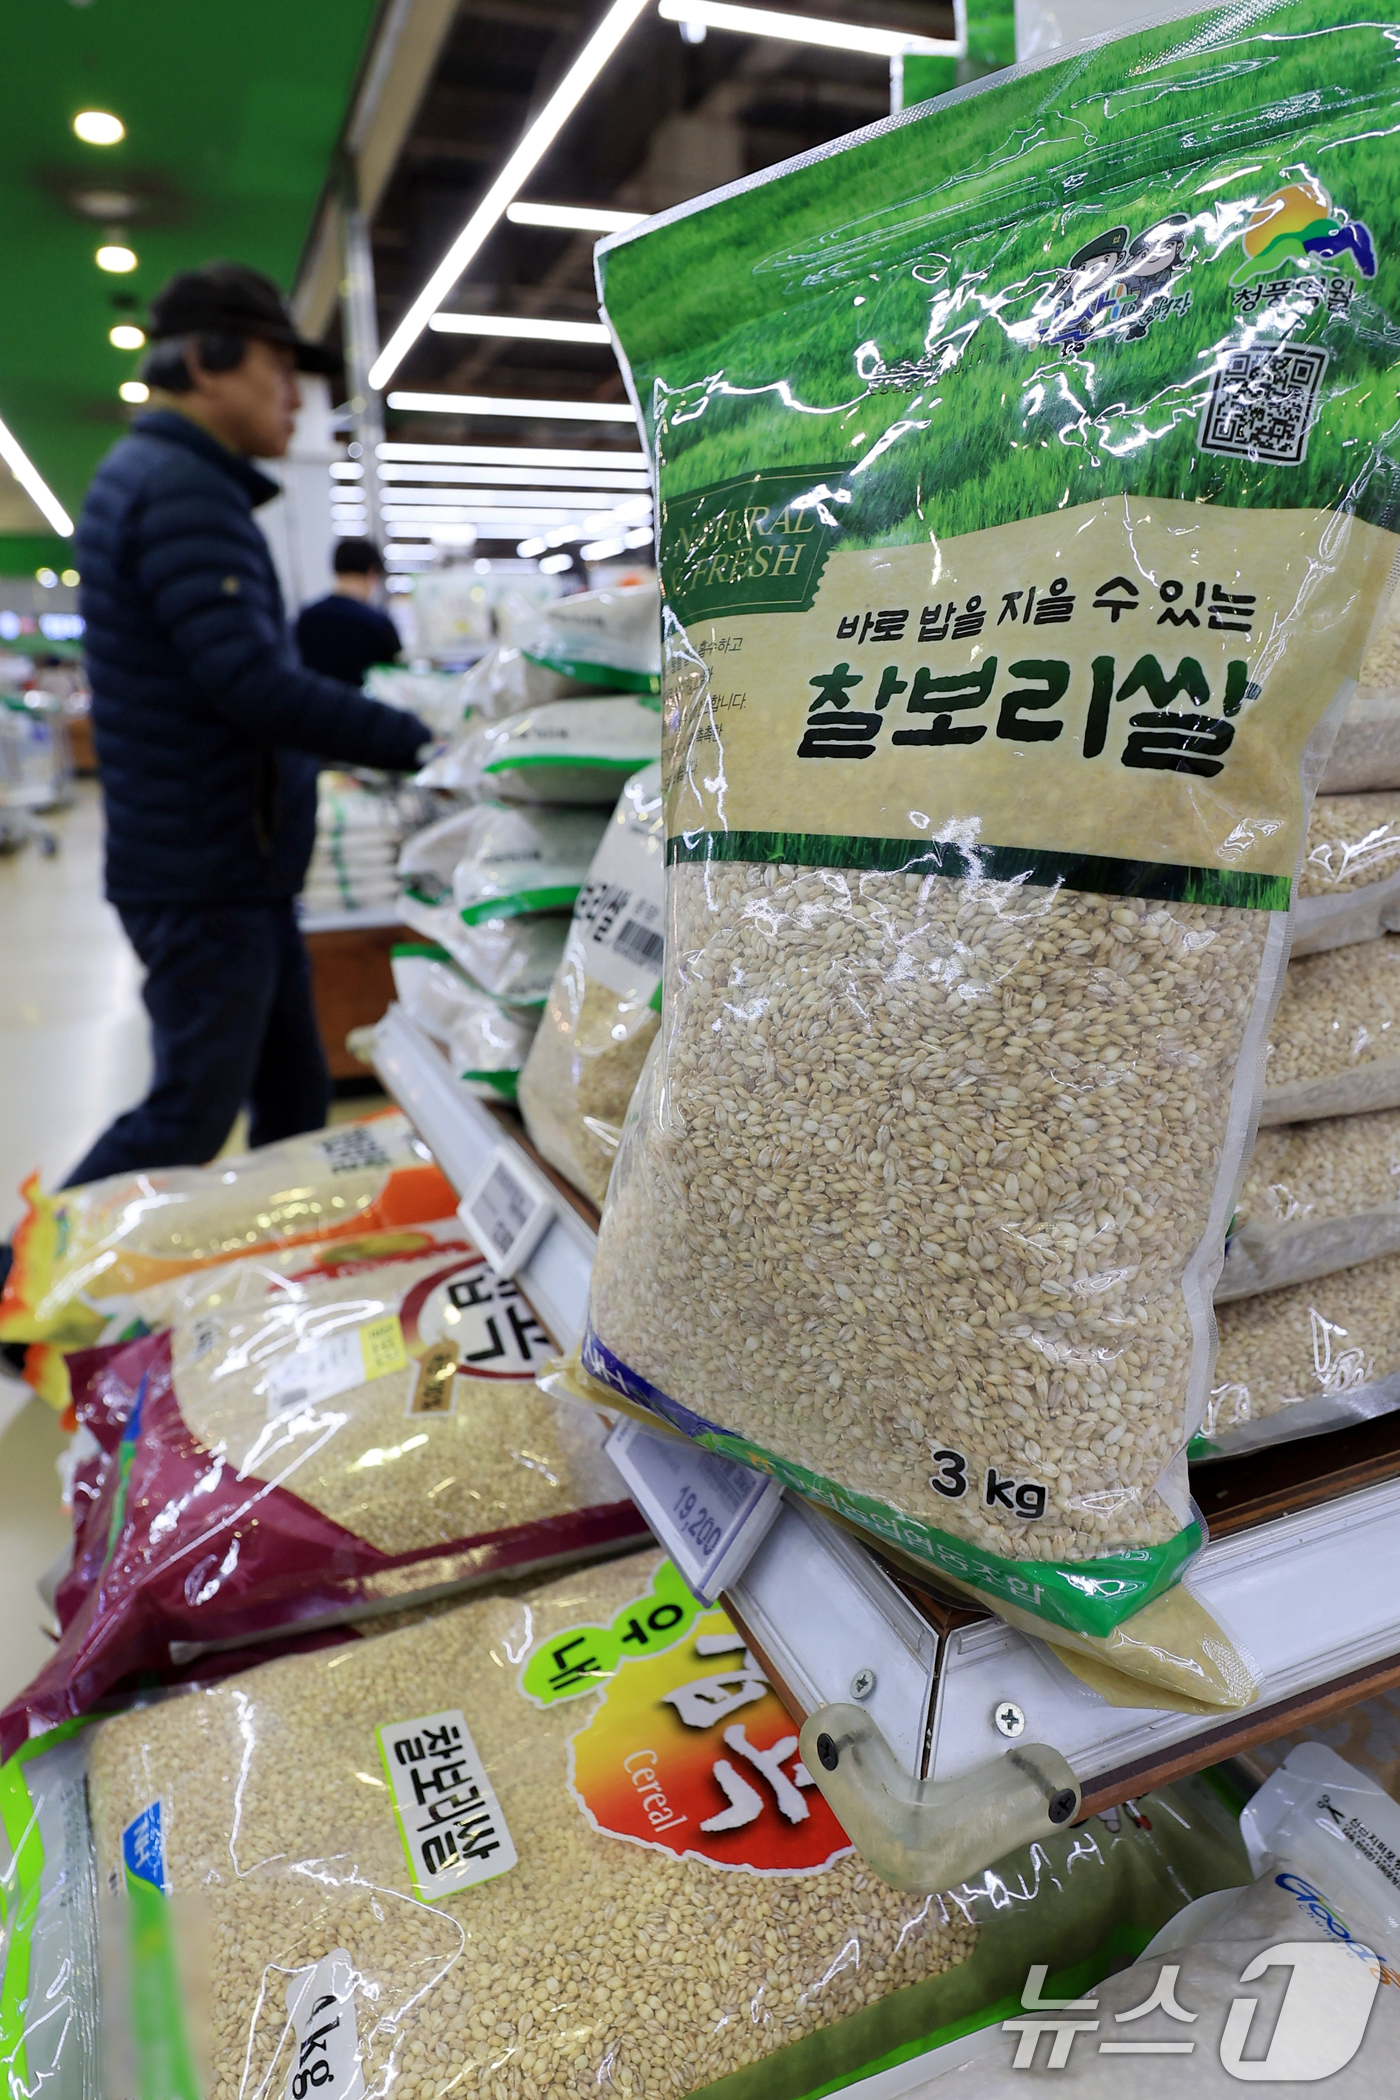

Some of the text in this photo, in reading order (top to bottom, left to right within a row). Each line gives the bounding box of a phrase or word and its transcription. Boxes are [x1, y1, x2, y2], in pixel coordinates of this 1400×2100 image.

[672, 505, 816, 558] NATURAL
[688, 543, 808, 591] FRESH
[836, 576, 1257, 645] 바로 밥을 지을 수 있는
[797, 653, 1258, 778] 찰보리쌀
[931, 1450, 1047, 1519] 3 kg
[673, 1485, 722, 1556] 19,200
[394, 1724, 501, 1875] 찰보리쌀
[623, 1749, 689, 1834] Cereal
[1275, 1873, 1388, 1963] Good
